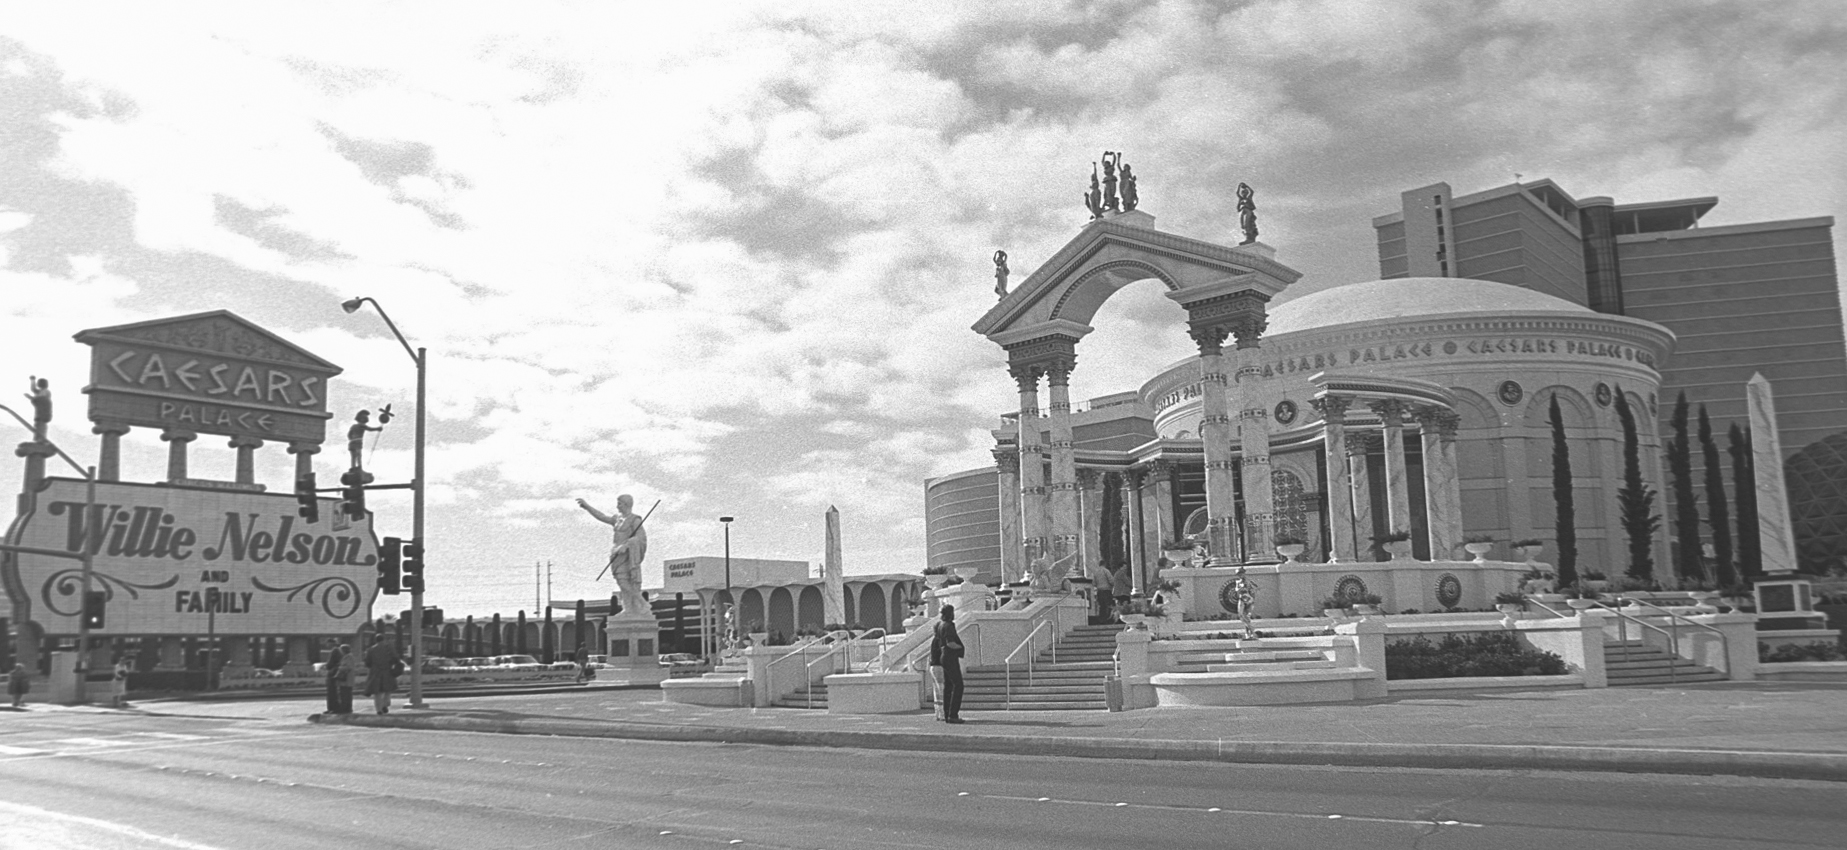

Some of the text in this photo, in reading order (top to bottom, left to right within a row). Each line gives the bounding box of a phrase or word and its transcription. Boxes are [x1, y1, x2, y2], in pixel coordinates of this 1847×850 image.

[1262, 352, 1338, 378] AESARS
[1351, 341, 1432, 365] PALACE
[1466, 339, 1557, 354] CAESARS
[1566, 340, 1622, 359] PALACE
[108, 350, 319, 407] CAESARS
[160, 402, 277, 431] PALACE
[47, 501, 378, 566] Willie Nelson
[200, 570, 229, 583] AND
[669, 562, 696, 570] CAESARS
[671, 570, 694, 578] PALACE
[175, 590, 253, 613] FAMILY
